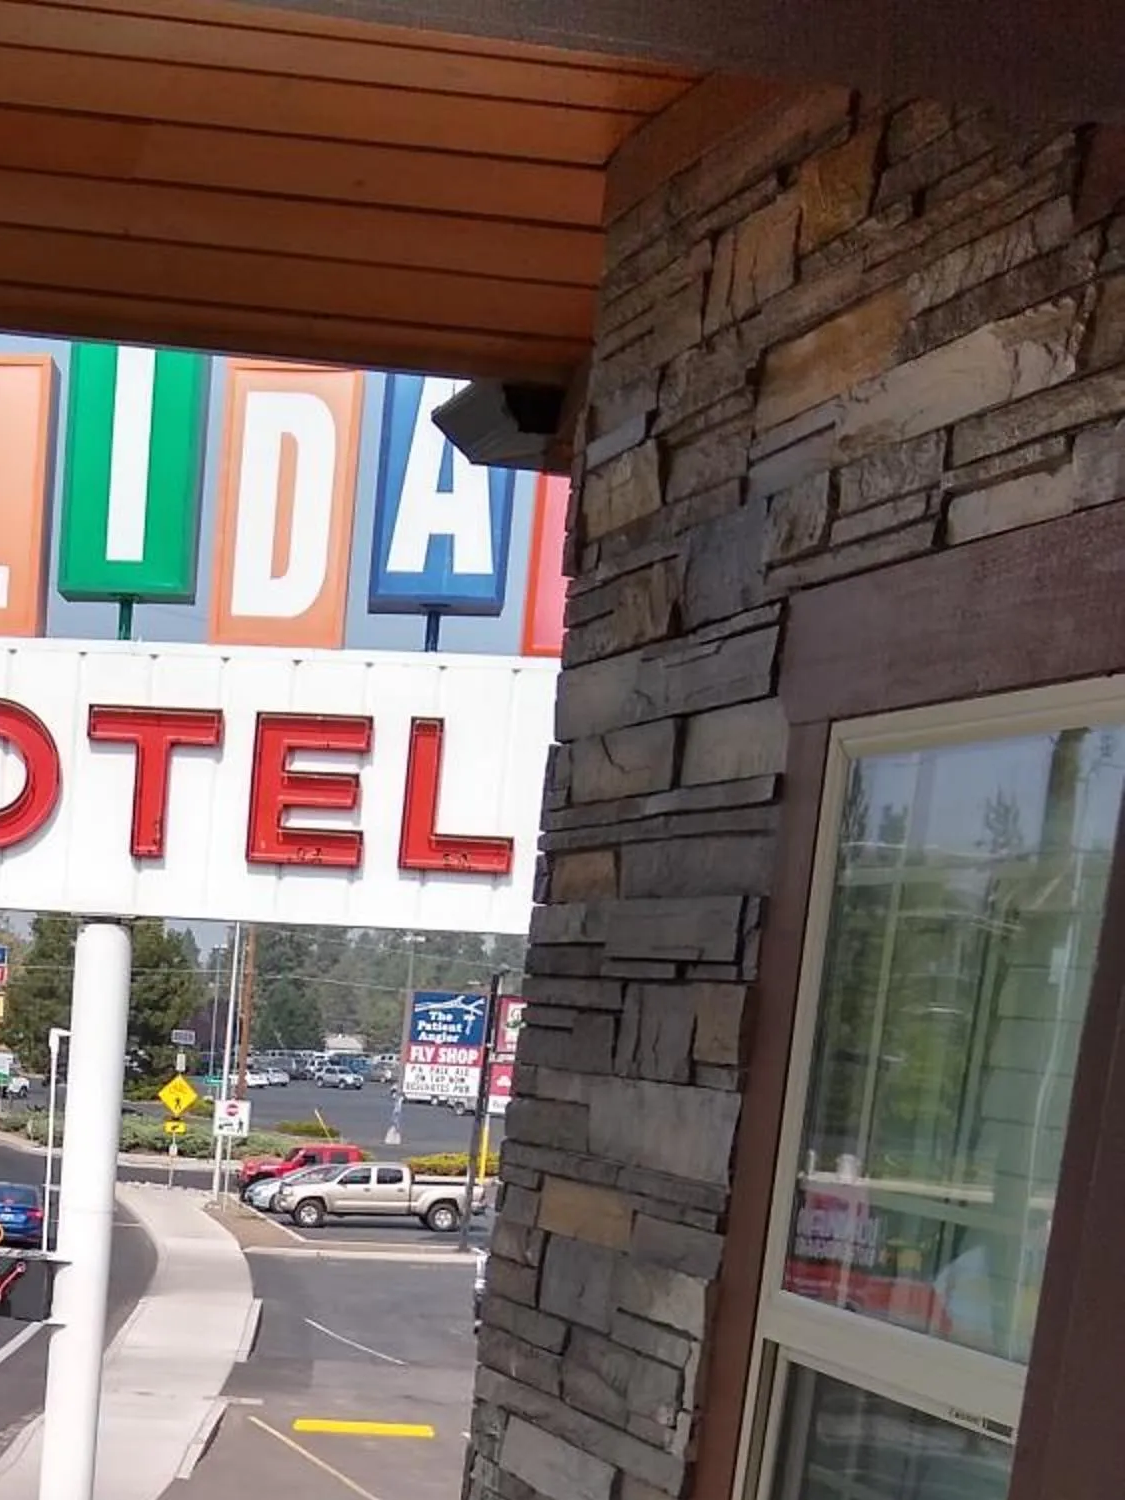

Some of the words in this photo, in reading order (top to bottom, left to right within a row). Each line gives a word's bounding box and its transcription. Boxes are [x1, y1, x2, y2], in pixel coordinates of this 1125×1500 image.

[428, 1011, 453, 1021] The
[417, 1020, 463, 1033] Patient
[418, 1031, 459, 1044] Angler
[410, 1045, 435, 1062] FLY
[438, 1047, 479, 1065] SHOP
